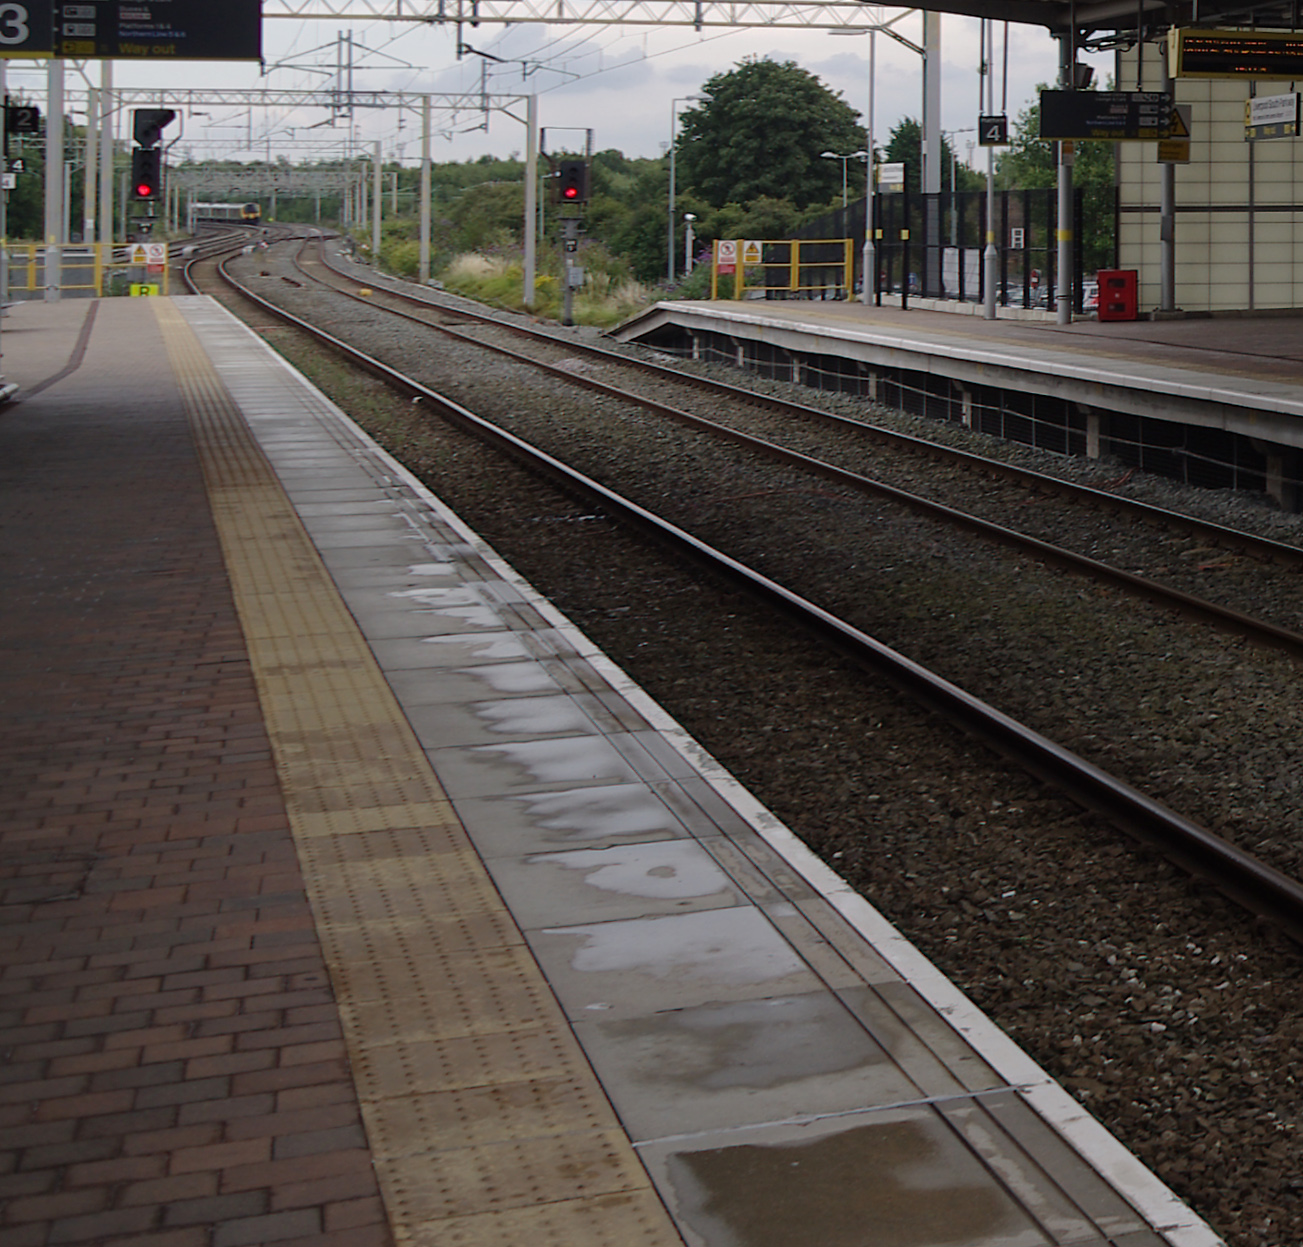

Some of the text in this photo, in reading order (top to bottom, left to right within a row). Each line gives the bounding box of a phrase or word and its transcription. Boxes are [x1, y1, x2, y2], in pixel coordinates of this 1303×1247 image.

[0, 2, 30, 45] 3
[119, 43, 176, 56] Way out
[16, 108, 33, 127] 2
[985, 124, 1002, 142] 4
[140, 286, 150, 296] R
